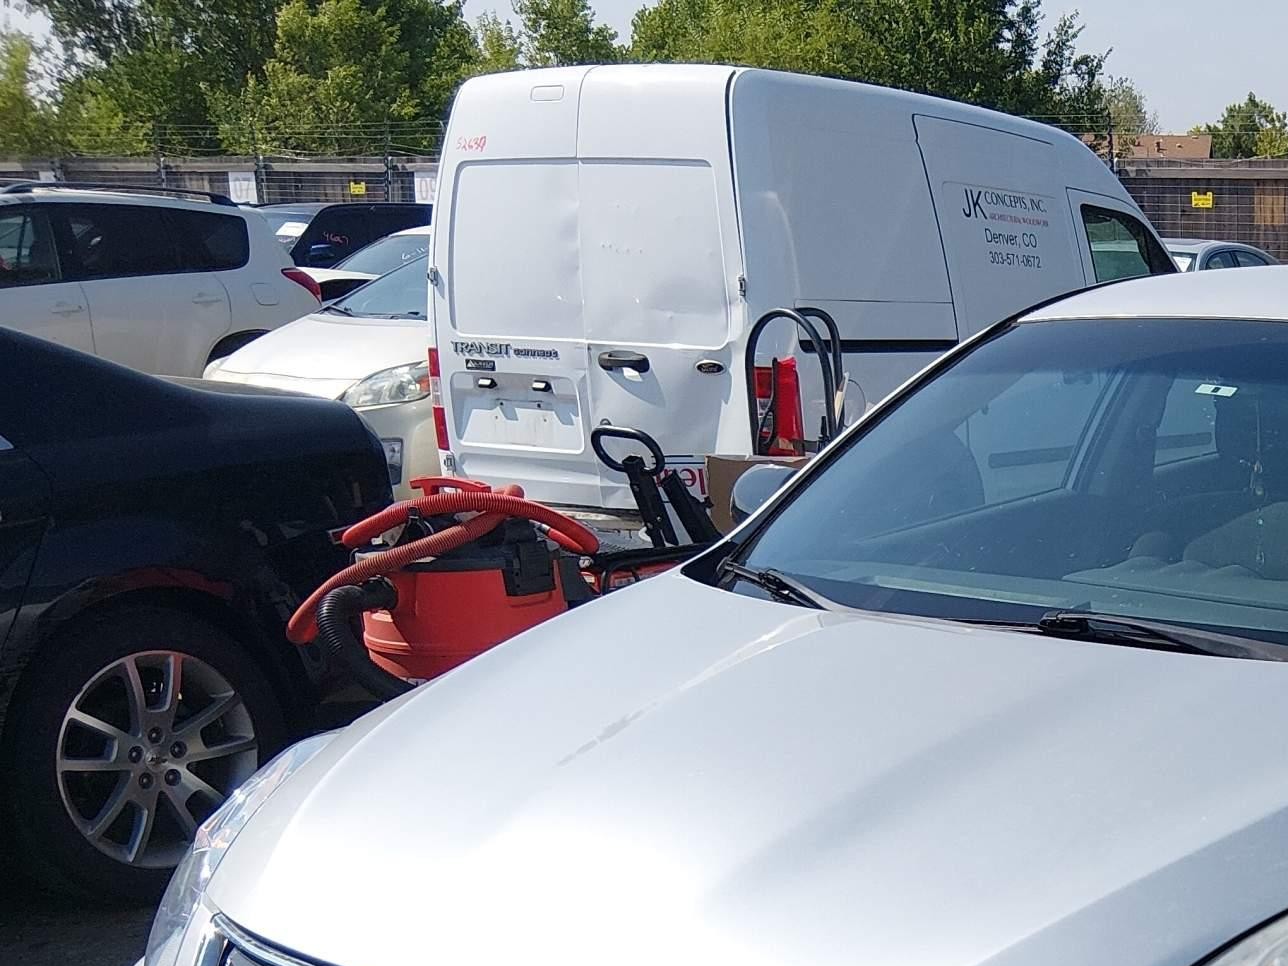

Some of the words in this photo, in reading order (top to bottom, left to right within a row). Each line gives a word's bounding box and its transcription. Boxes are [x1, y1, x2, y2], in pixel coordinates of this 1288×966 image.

[962, 188, 988, 219] JK
[984, 191, 1030, 212] CONCEPTS,
[1030, 198, 1047, 213] INC.
[984, 228, 1021, 248] Denver,
[1022, 232, 1037, 248] CO
[988, 251, 1042, 269] 303-571-0672
[451, 341, 511, 356] TRANSIT
